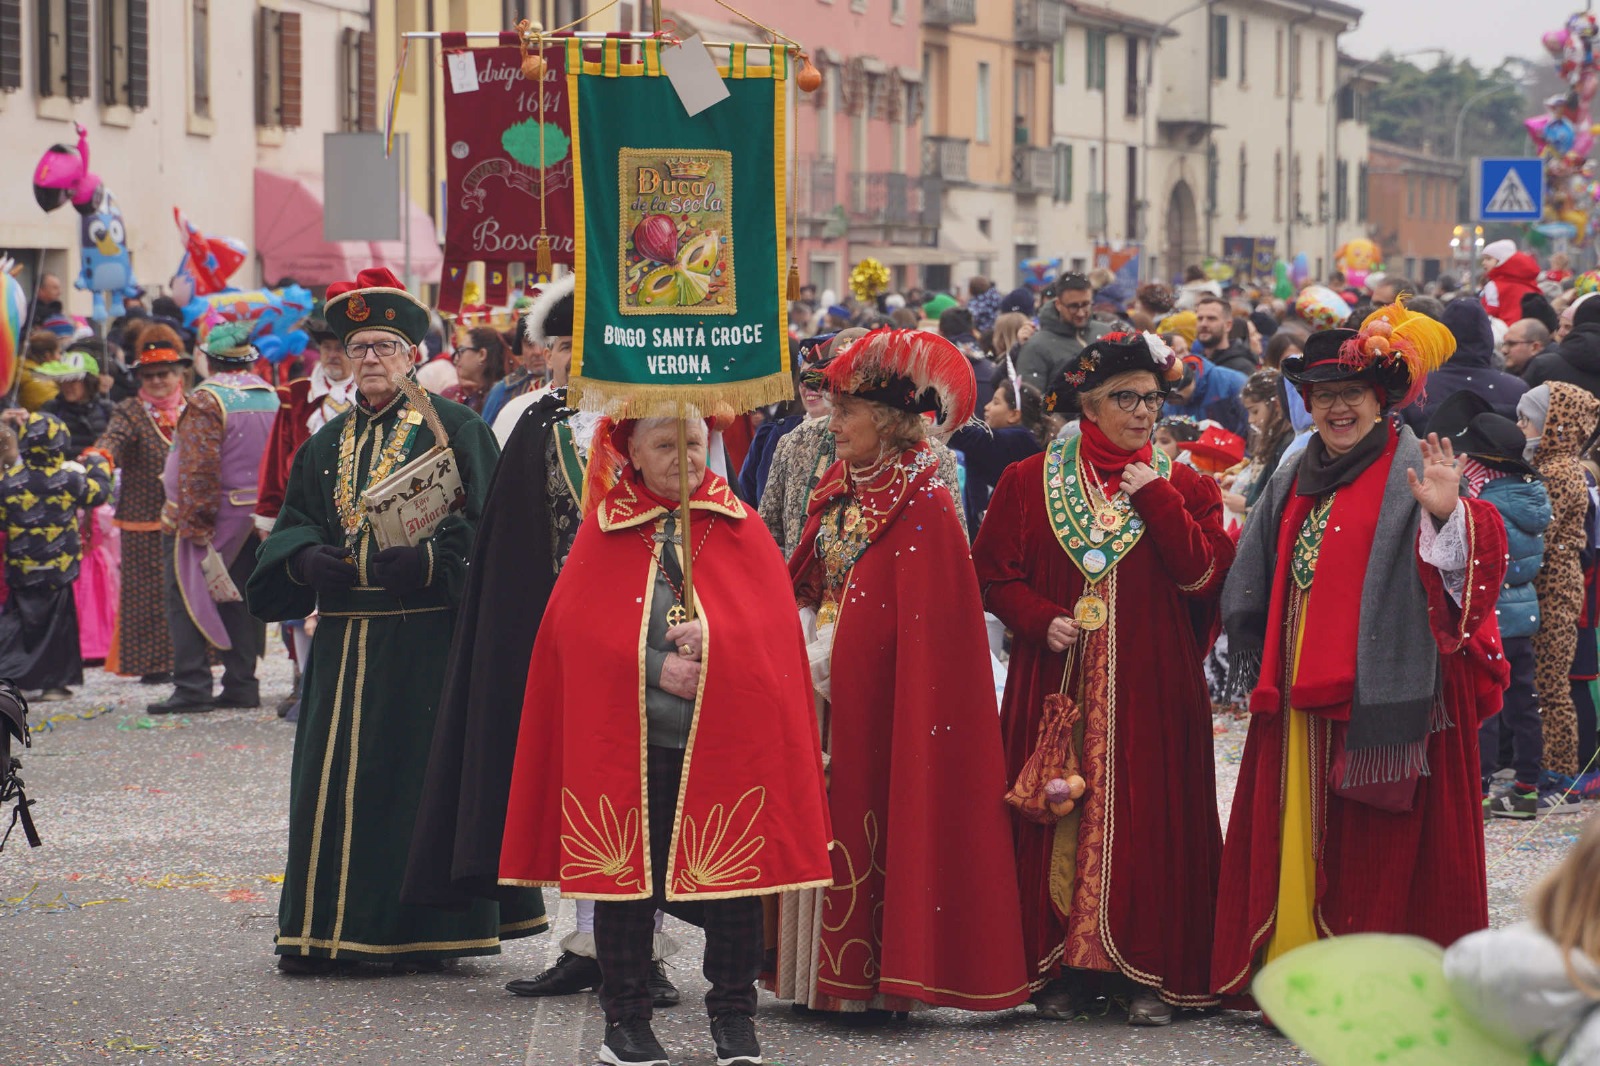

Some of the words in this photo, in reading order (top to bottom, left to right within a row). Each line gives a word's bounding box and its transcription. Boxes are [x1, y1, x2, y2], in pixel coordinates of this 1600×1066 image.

[516, 91, 561, 112] 1641
[637, 167, 705, 196] Duca
[631, 196, 648, 211] de
[650, 195, 667, 211] la
[604, 324, 646, 348] BORGO
[652, 327, 706, 348] SANTA
[711, 324, 763, 346] CROCE
[647, 355, 711, 375] VERONA
